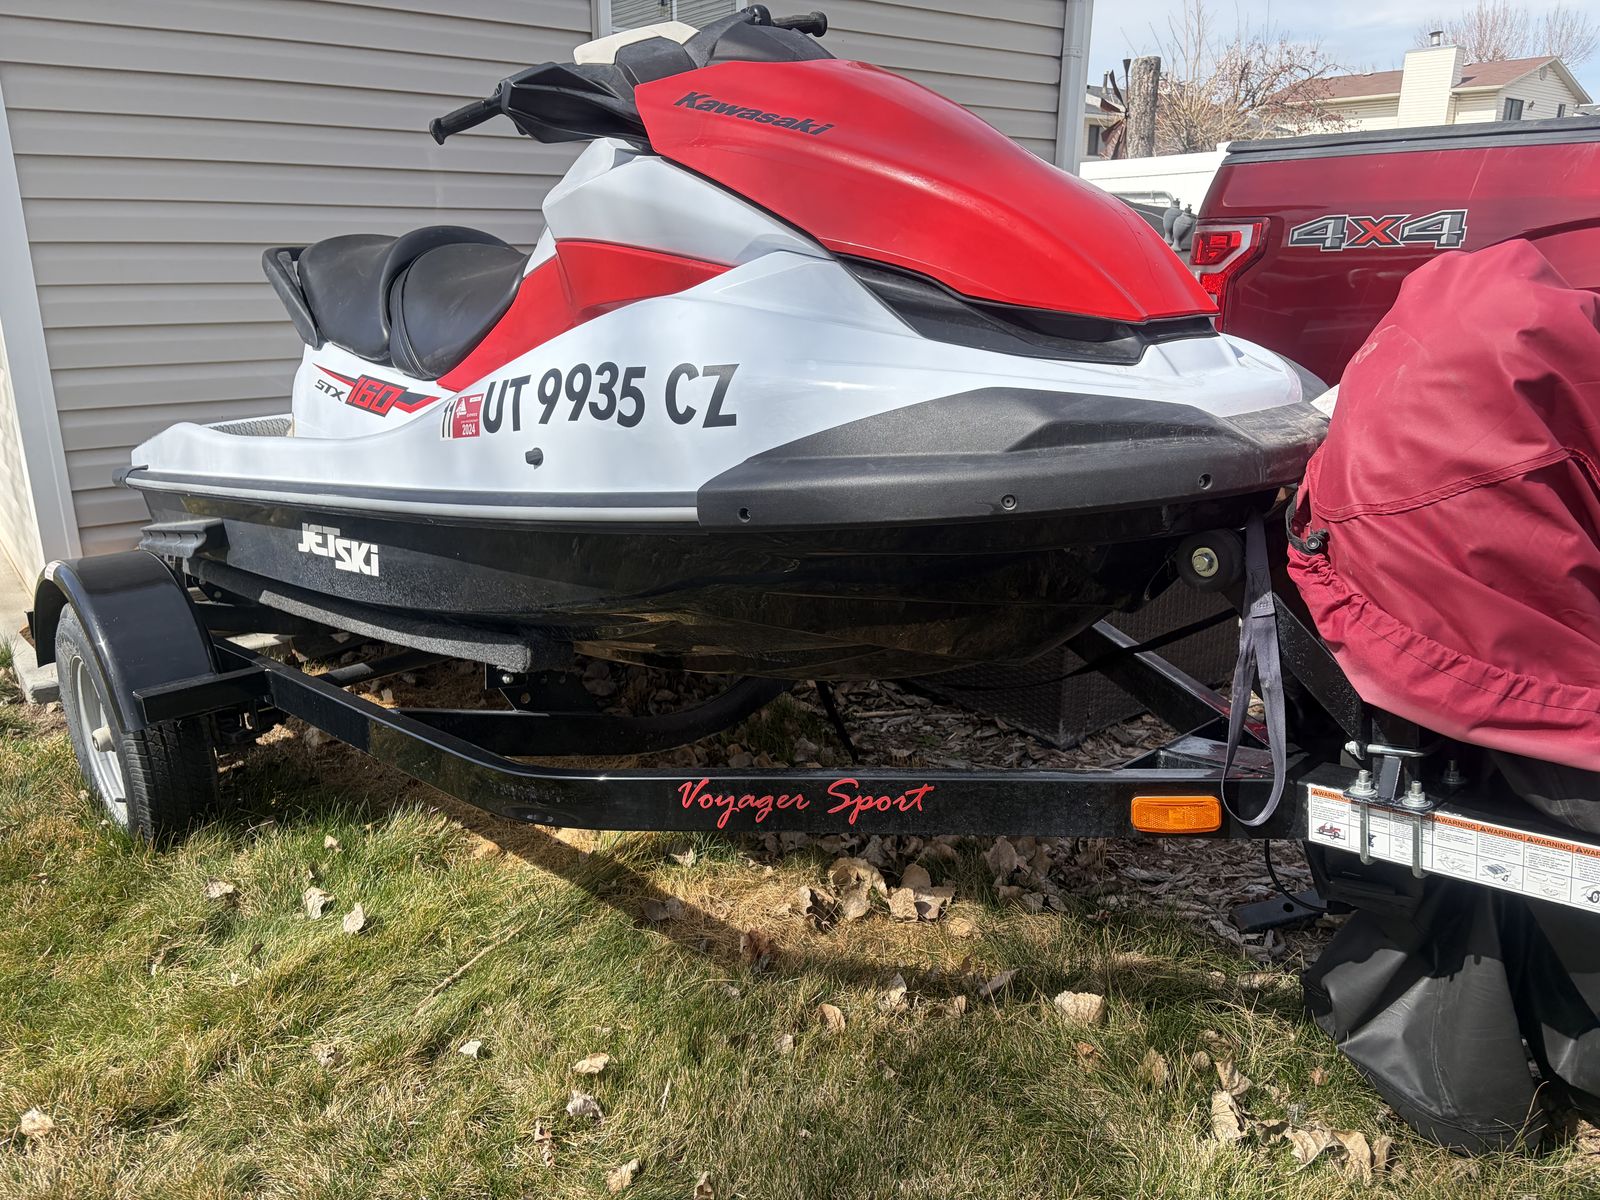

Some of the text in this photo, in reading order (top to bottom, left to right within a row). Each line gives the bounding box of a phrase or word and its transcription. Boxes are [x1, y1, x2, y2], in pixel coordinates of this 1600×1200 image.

[673, 91, 834, 135] Kawasaki
[314, 376, 405, 414] STX 160
[482, 361, 740, 433] UT 9935 CZ
[462, 423, 476, 435] 2024
[298, 522, 340, 558] JET
[678, 777, 935, 829] Voyager Sport
[1319, 790, 1349, 802] WARNIN
[1441, 817, 1476, 830] WARNING
[1485, 827, 1522, 840] WARNING
[1532, 839, 1571, 851] WARNING
